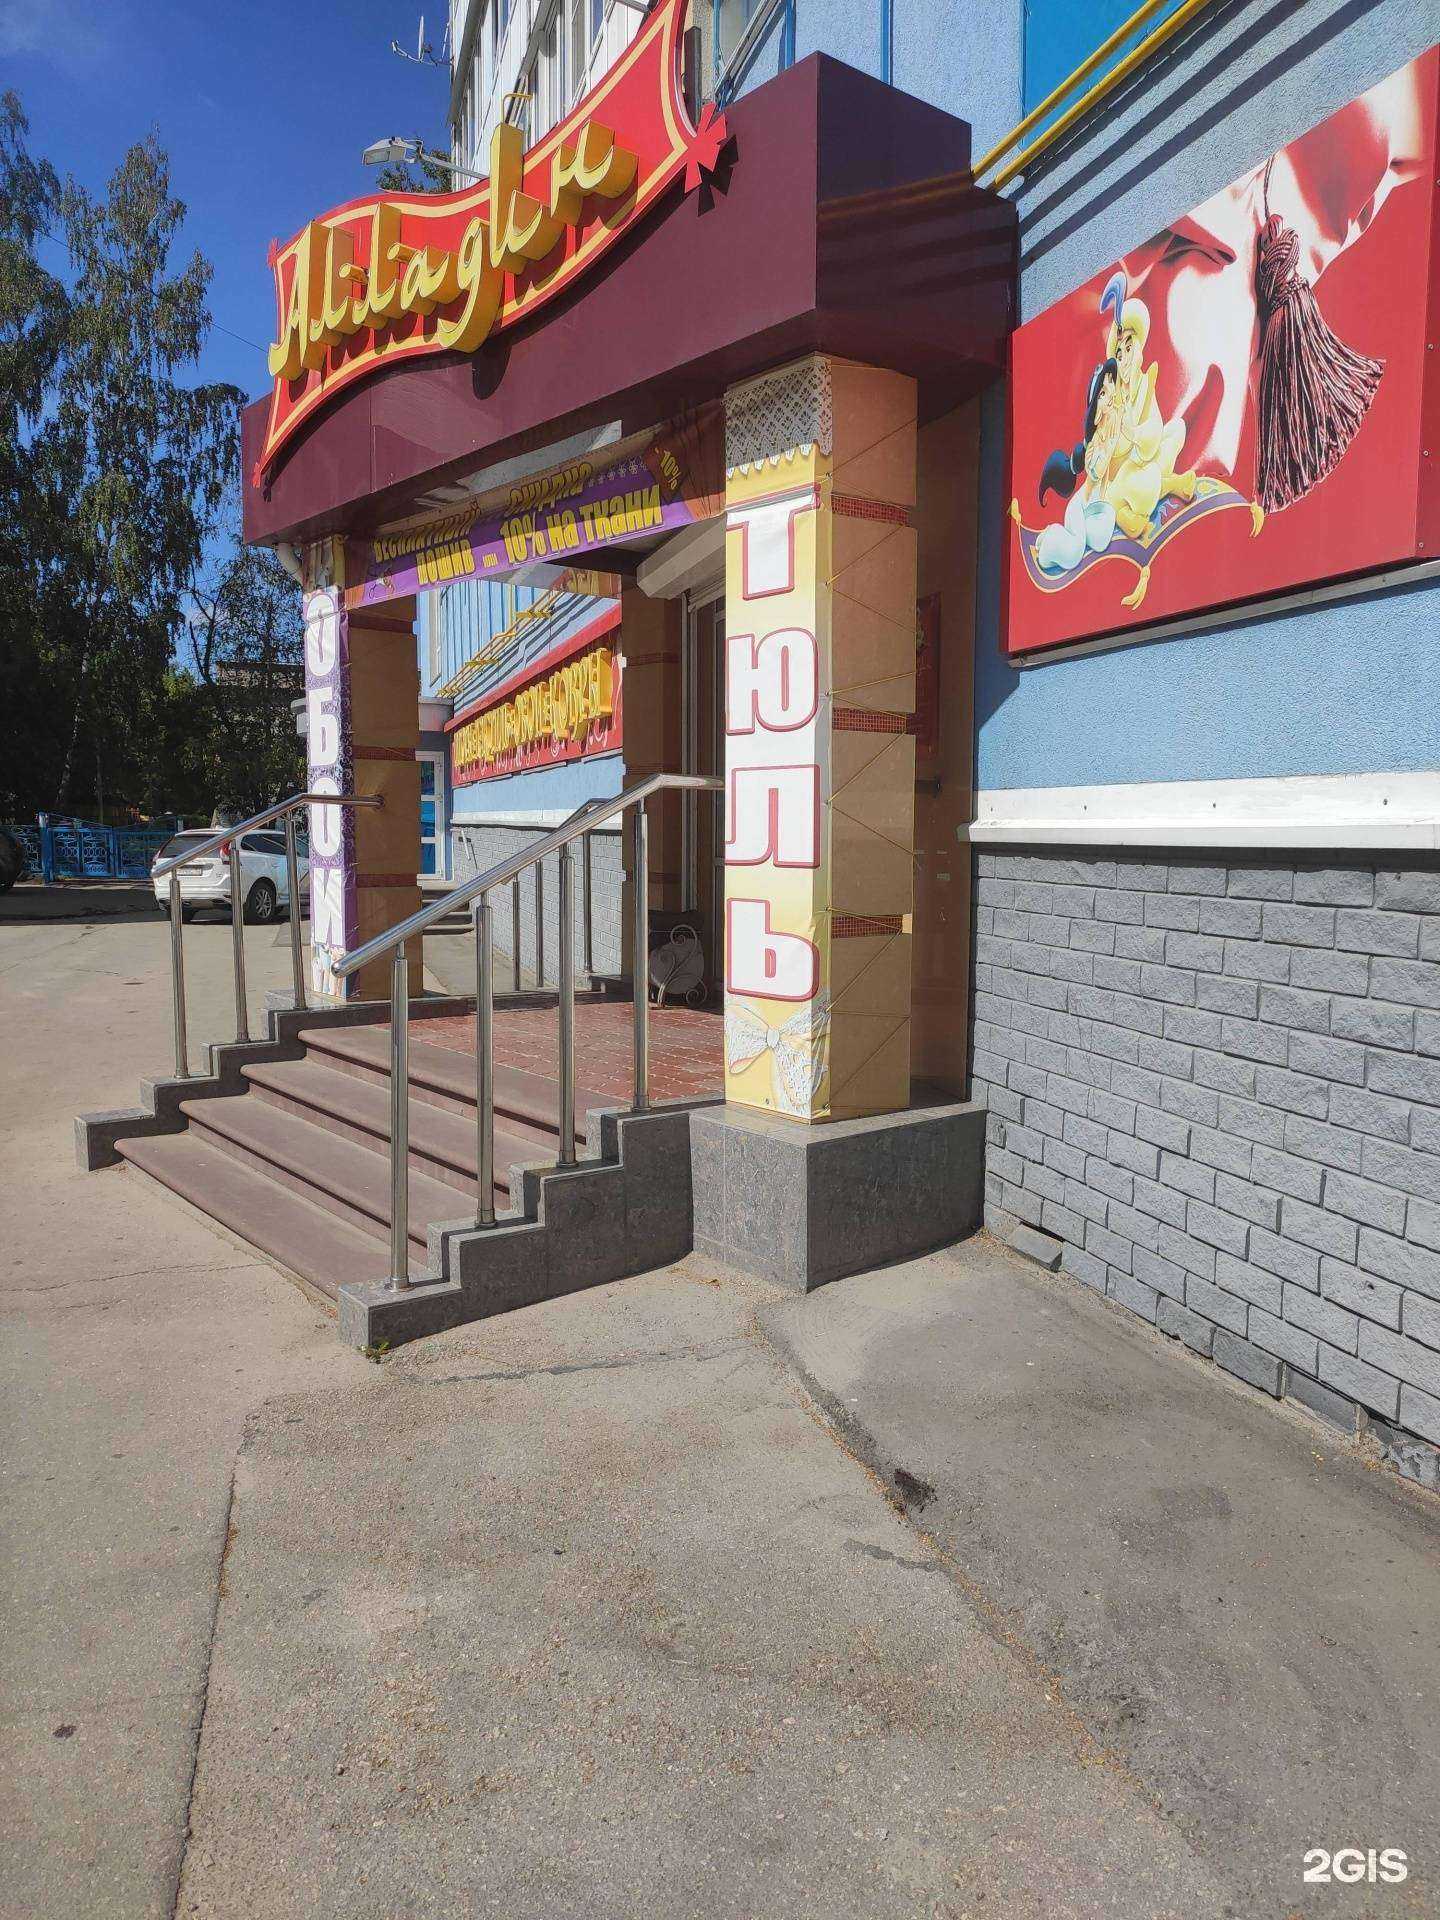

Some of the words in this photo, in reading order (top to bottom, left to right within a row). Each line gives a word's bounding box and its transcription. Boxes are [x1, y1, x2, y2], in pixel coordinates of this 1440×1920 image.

[499, 511, 547, 564] 10%
[546, 509, 580, 552] на
[579, 484, 664, 543] ткани
[306, 593, 343, 947] ОБОИ
[725, 484, 822, 1003] ТЮЛЬ
